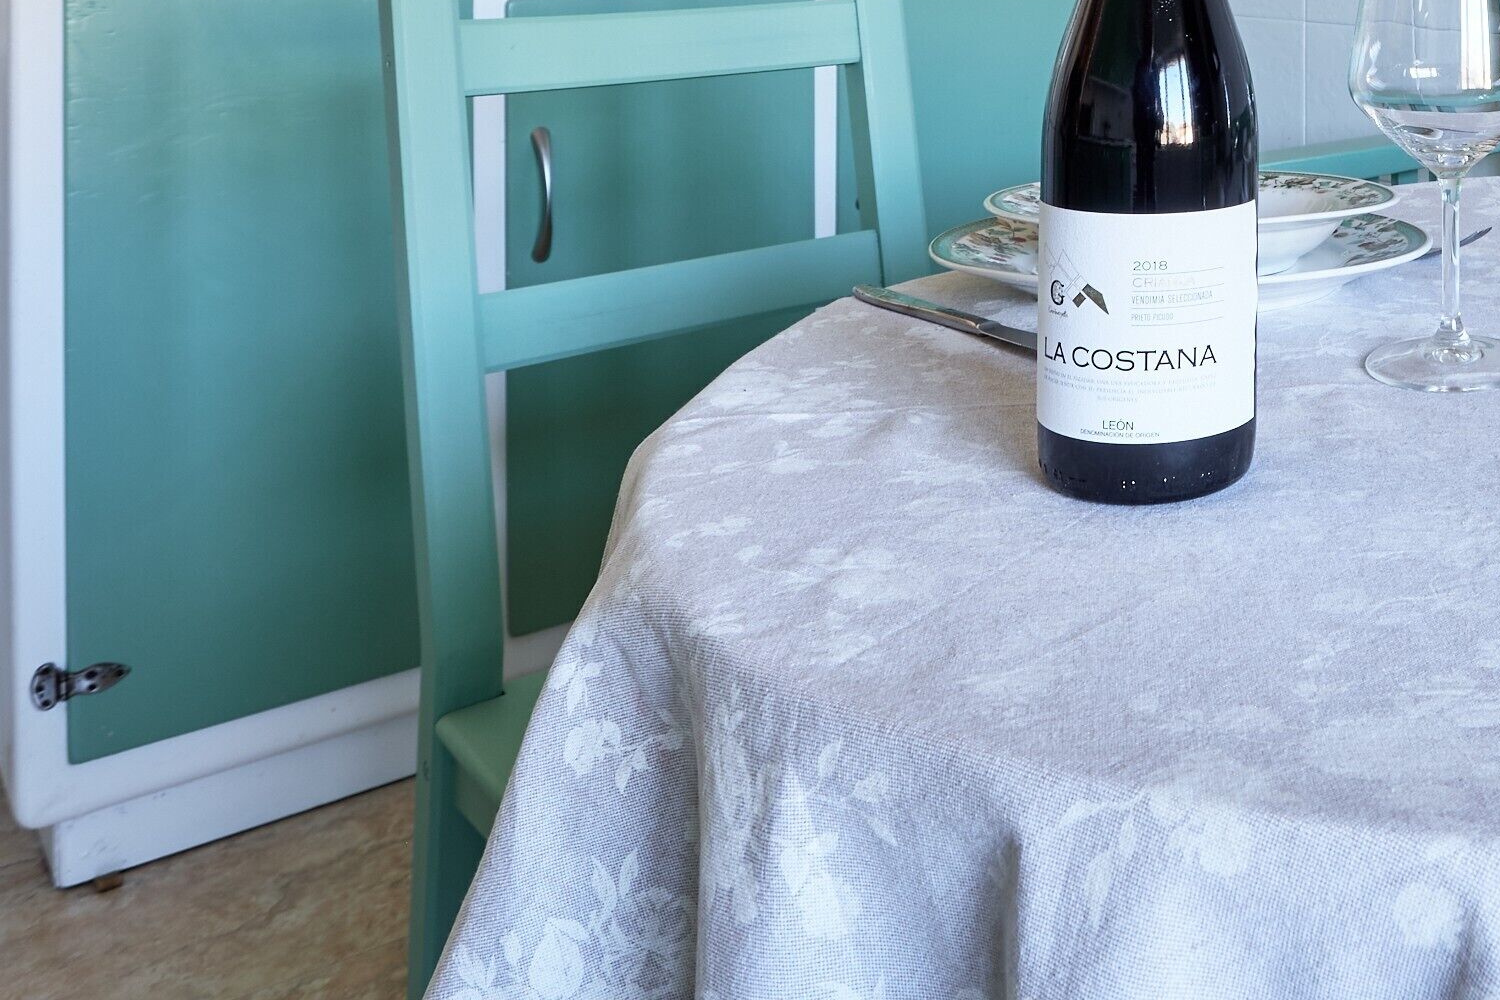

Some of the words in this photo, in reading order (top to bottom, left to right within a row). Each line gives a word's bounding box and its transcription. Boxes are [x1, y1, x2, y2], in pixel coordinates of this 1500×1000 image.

[1133, 260, 1168, 271] 2018
[1044, 336, 1066, 364] LA
[1071, 344, 1217, 371] COSTANA
[1102, 418, 1134, 430] LEÓN
